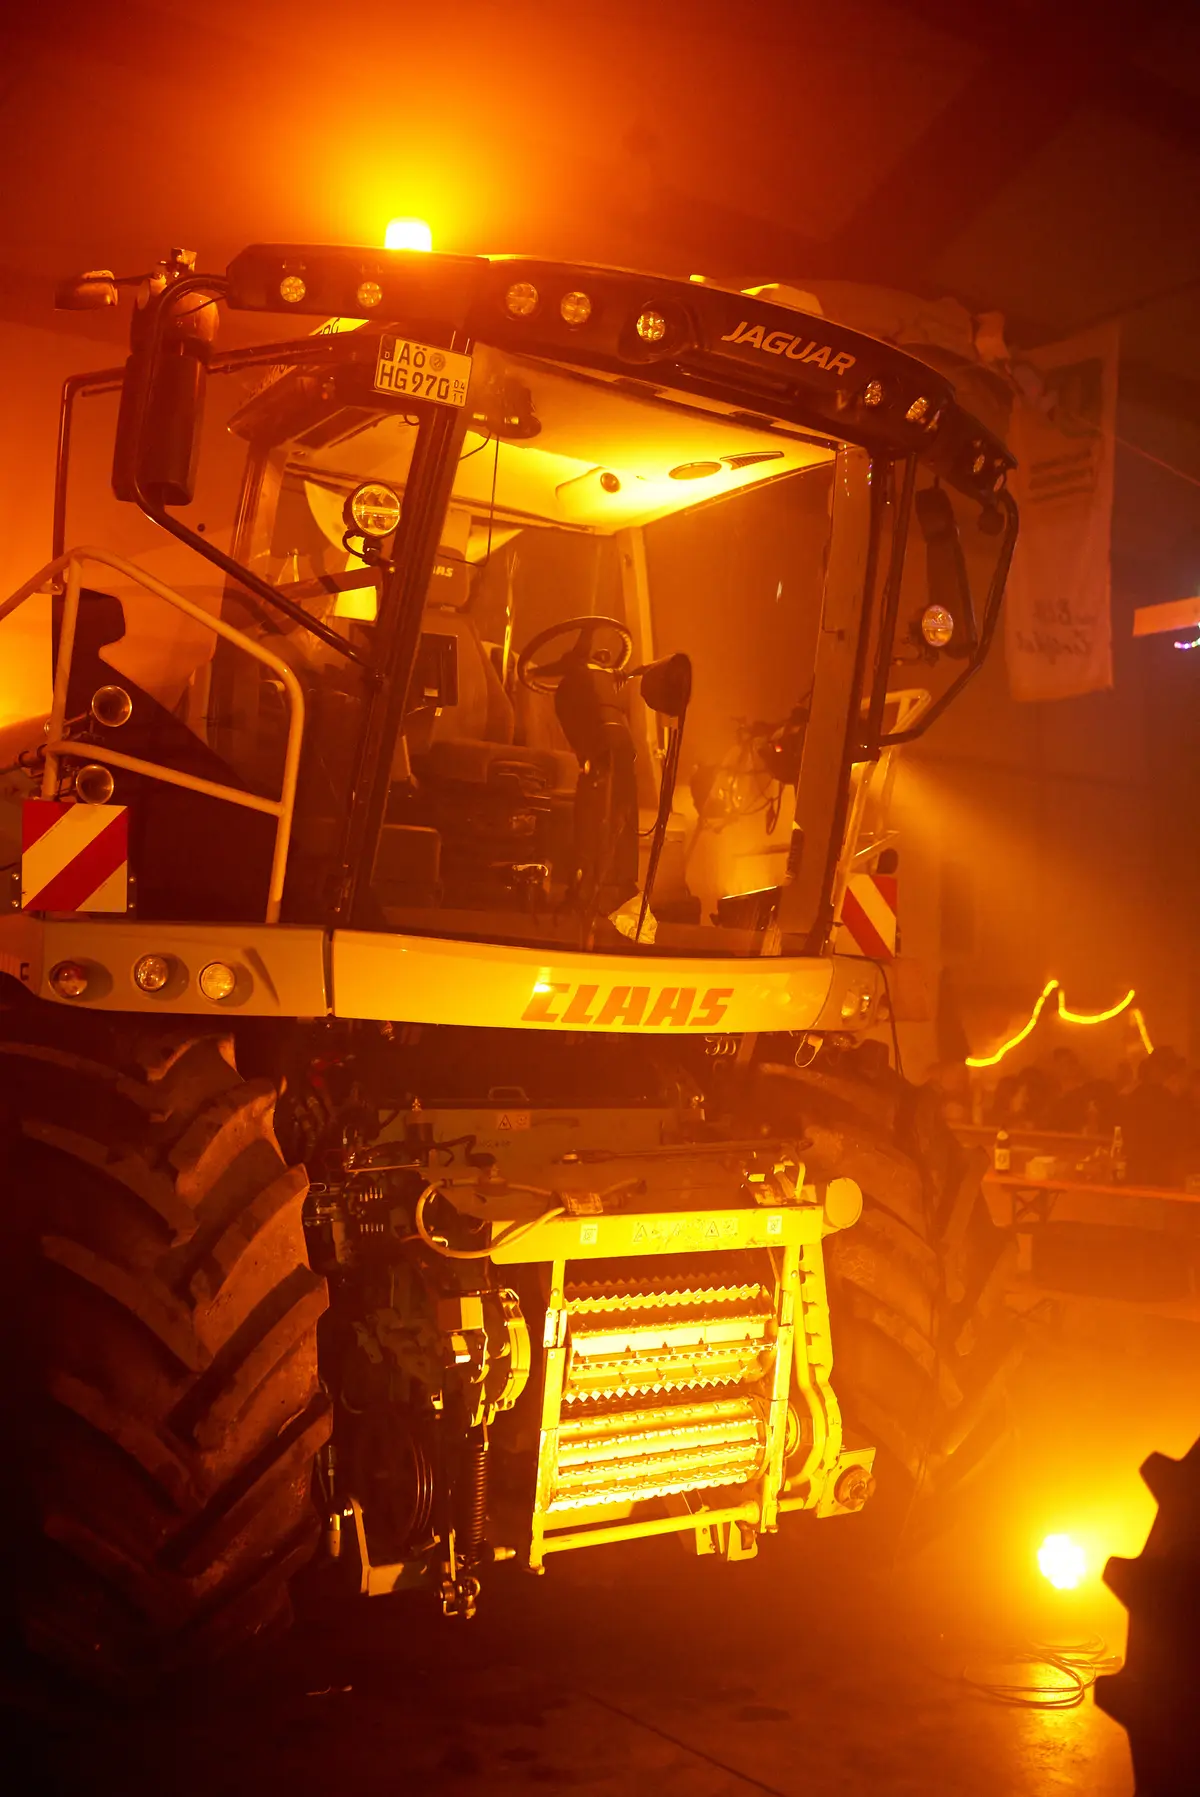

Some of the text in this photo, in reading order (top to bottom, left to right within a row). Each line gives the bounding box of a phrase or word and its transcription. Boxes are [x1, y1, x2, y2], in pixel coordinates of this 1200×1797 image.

[397, 342, 427, 369] AÖ
[721, 321, 856, 376] JAGUAR
[453, 379, 465, 391] 04
[453, 393, 463, 404] 11
[521, 983, 735, 1027] CLAAS
